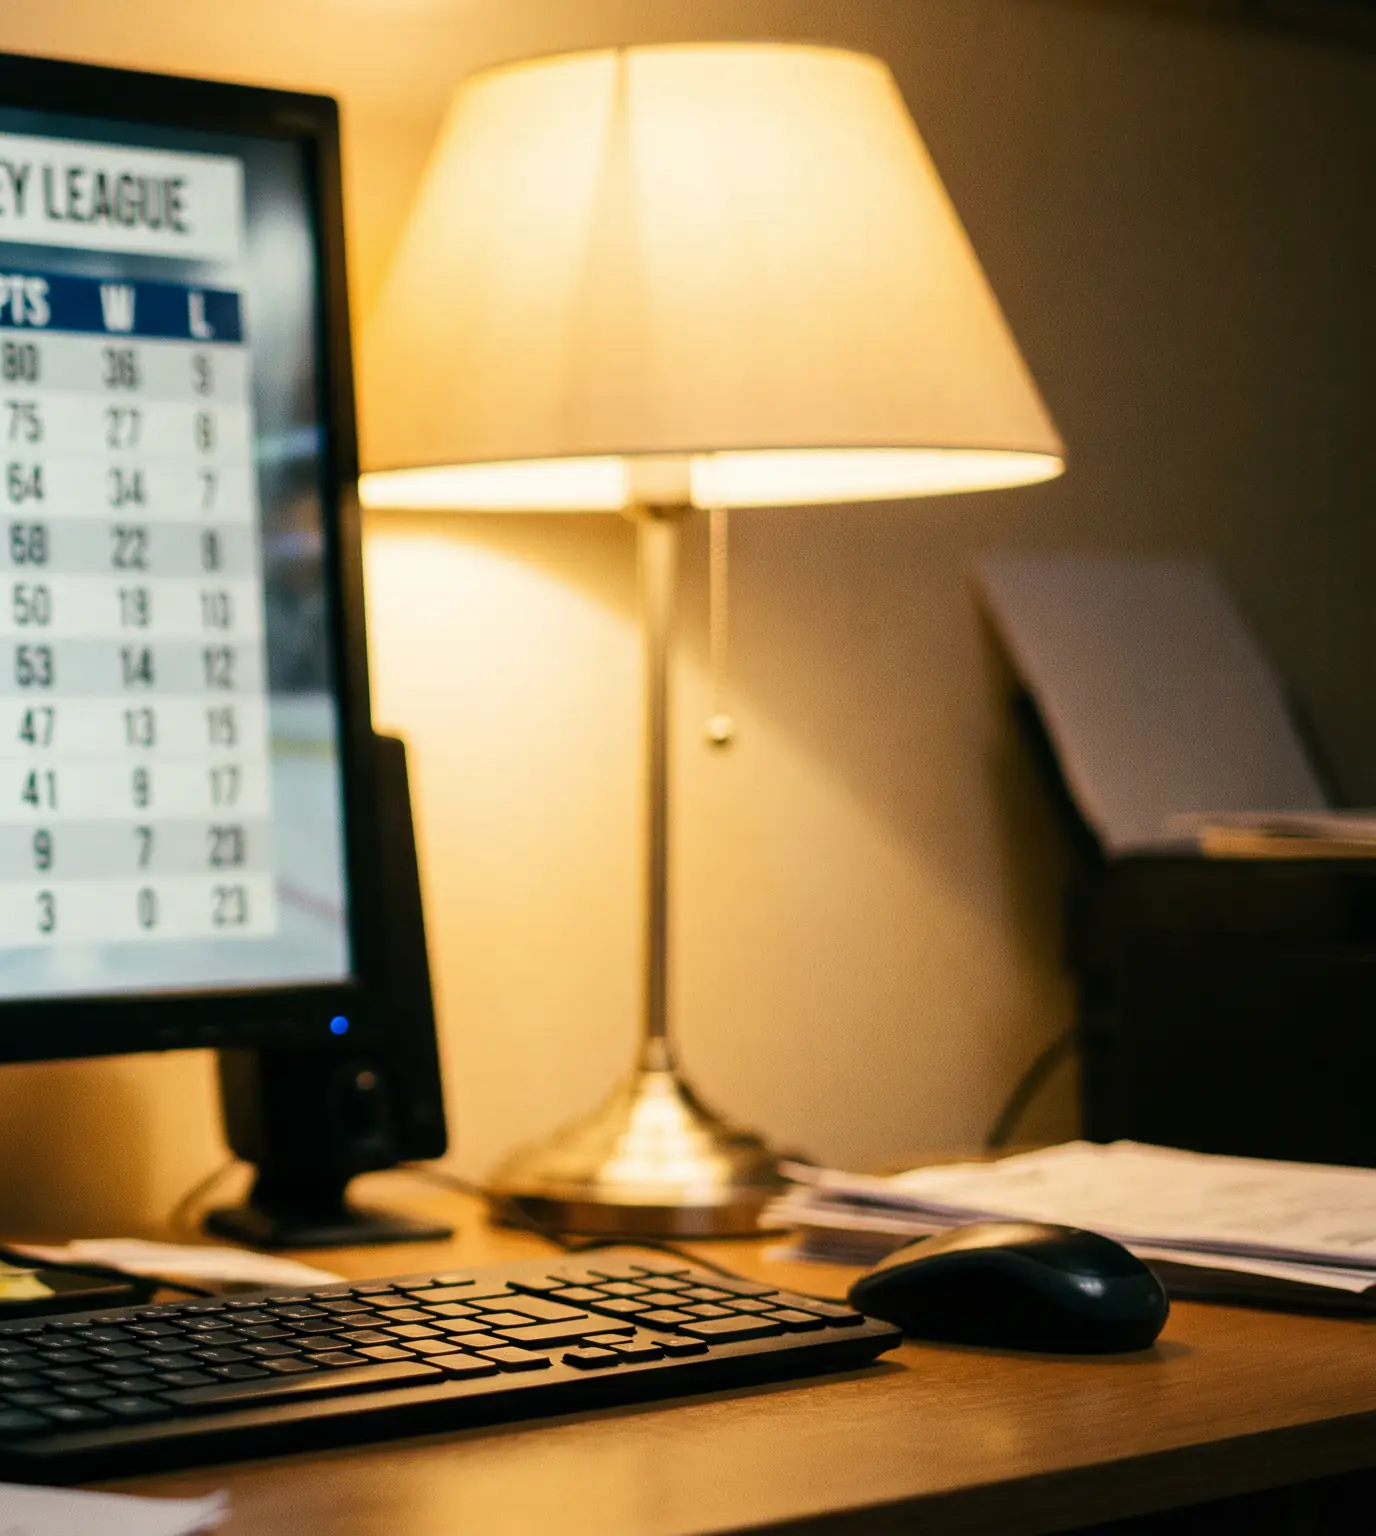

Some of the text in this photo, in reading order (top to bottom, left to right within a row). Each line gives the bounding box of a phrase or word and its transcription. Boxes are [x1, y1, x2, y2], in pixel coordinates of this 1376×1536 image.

[41, 165, 190, 236] LEAGUE
[99, 284, 135, 333] W
[187, 290, 214, 339] L
[4, 398, 45, 445] 75
[104, 404, 143, 450] 27
[6, 461, 46, 505] 64
[109, 466, 148, 509] 34
[197, 465, 220, 510] 7
[110, 523, 150, 572] 22
[12, 582, 52, 628] 50
[15, 644, 55, 690] 53
[120, 647, 155, 686] 14
[201, 644, 237, 692] 12
[18, 706, 56, 746] 47
[123, 706, 157, 750] 13
[206, 704, 238, 748] 15
[21, 770, 56, 809] 41
[208, 762, 243, 808] 17
[32, 828, 54, 873] 9
[134, 824, 155, 869] 7
[36, 889, 57, 936] 3
[137, 886, 159, 931] 0
